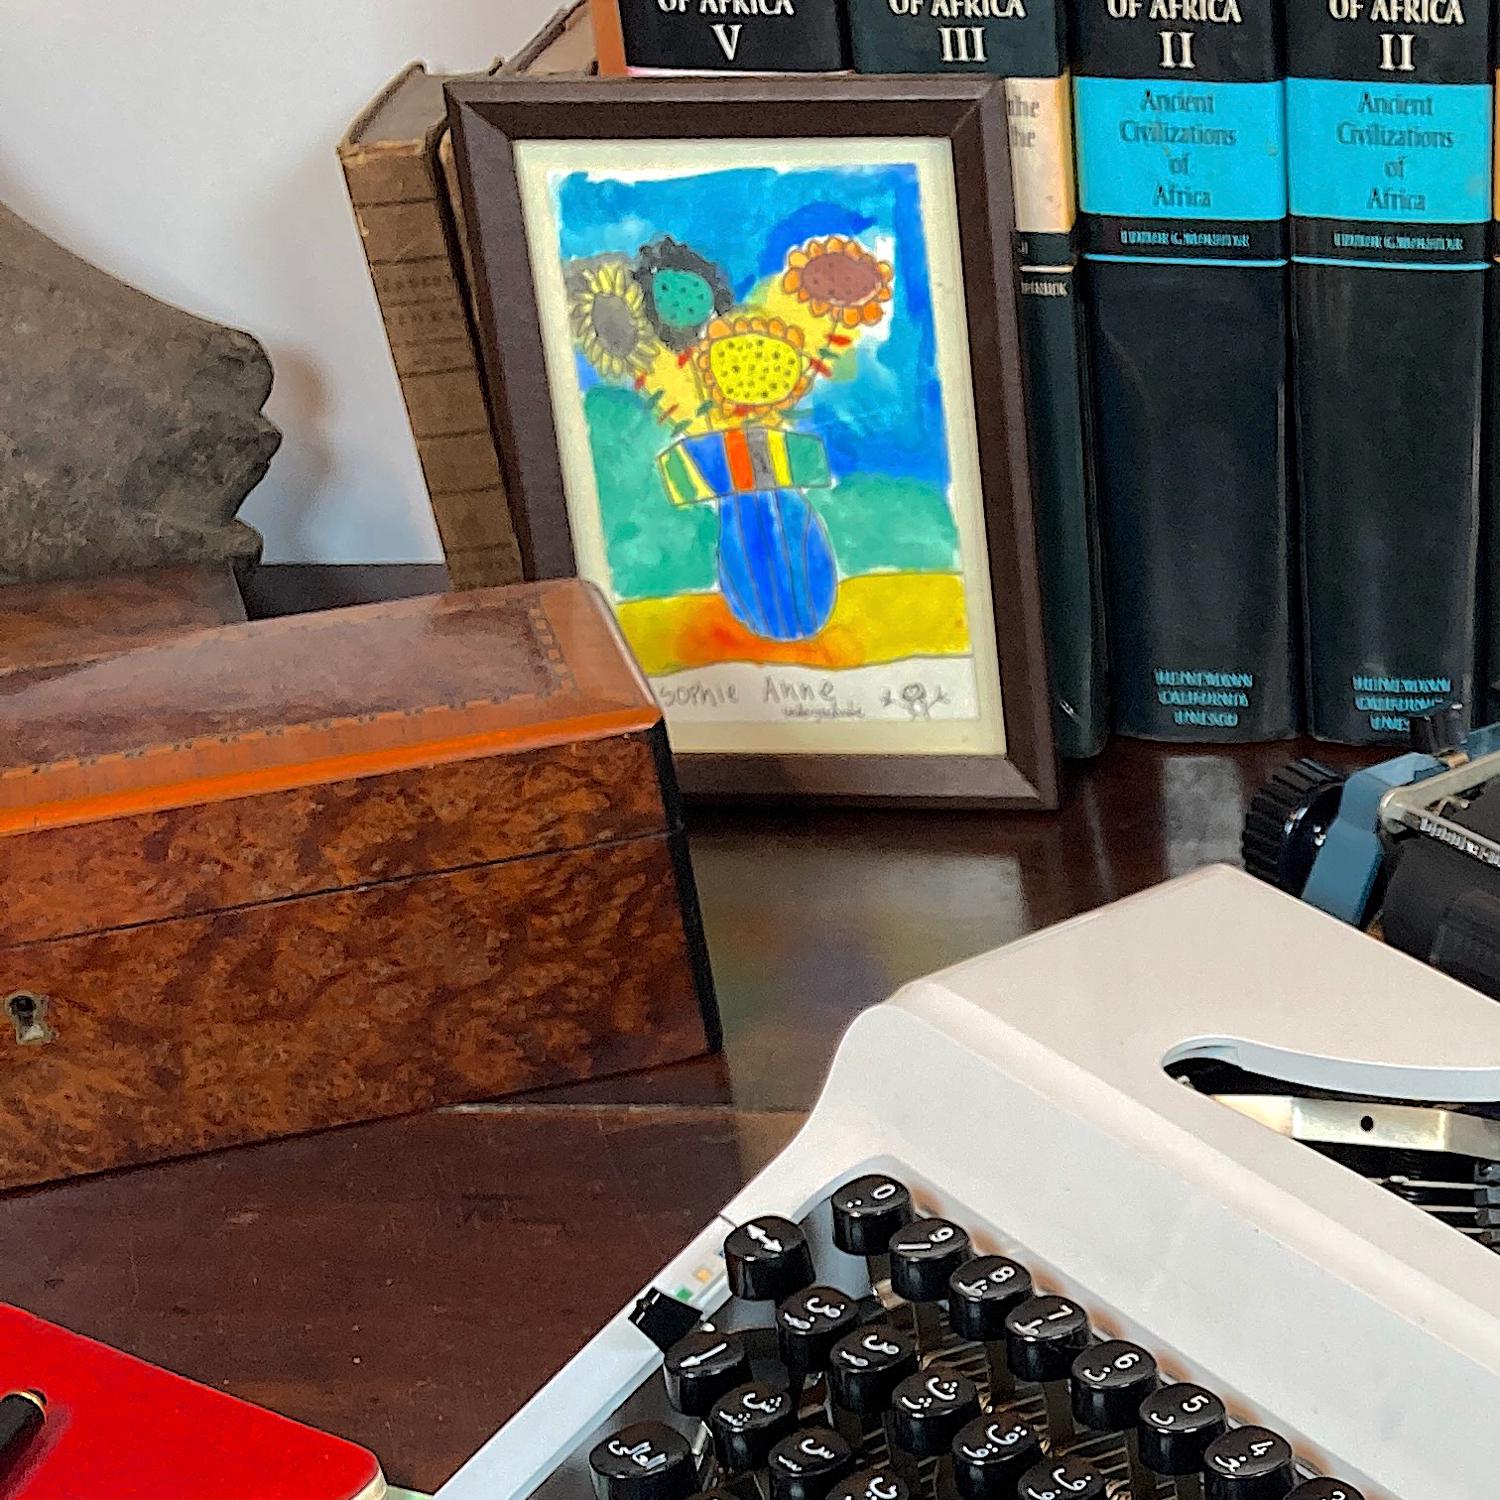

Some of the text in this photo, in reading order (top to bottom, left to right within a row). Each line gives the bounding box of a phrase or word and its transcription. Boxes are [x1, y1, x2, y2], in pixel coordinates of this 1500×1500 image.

[1149, 0, 1243, 24] AFRICA
[1369, 0, 1465, 25] AFRICA
[709, 23, 743, 61] V
[937, 26, 988, 63] III
[1157, 32, 1197, 69] II
[1380, 33, 1417, 72] II
[1140, 90, 1214, 115] Ancient
[1357, 92, 1433, 116] Ancient
[1120, 120, 1236, 146] Civilizations
[1337, 121, 1455, 148] Civilizations
[1169, 152, 1189, 175] of
[1384, 154, 1407, 177] of
[1152, 185, 1212, 208] Africa
[1367, 187, 1426, 211] Africa
[872, 1183, 896, 1200] 0
[928, 1226, 954, 1243] 9
[989, 1266, 1015, 1283] 8
[1047, 1304, 1073, 1321] 7
[1114, 1353, 1140, 1369] 6
[1182, 1394, 1209, 1412] 5
[987, 1424, 1028, 1445] ق
[1250, 1440, 1274, 1456] 4
[1052, 1468, 1092, 1491] ف
